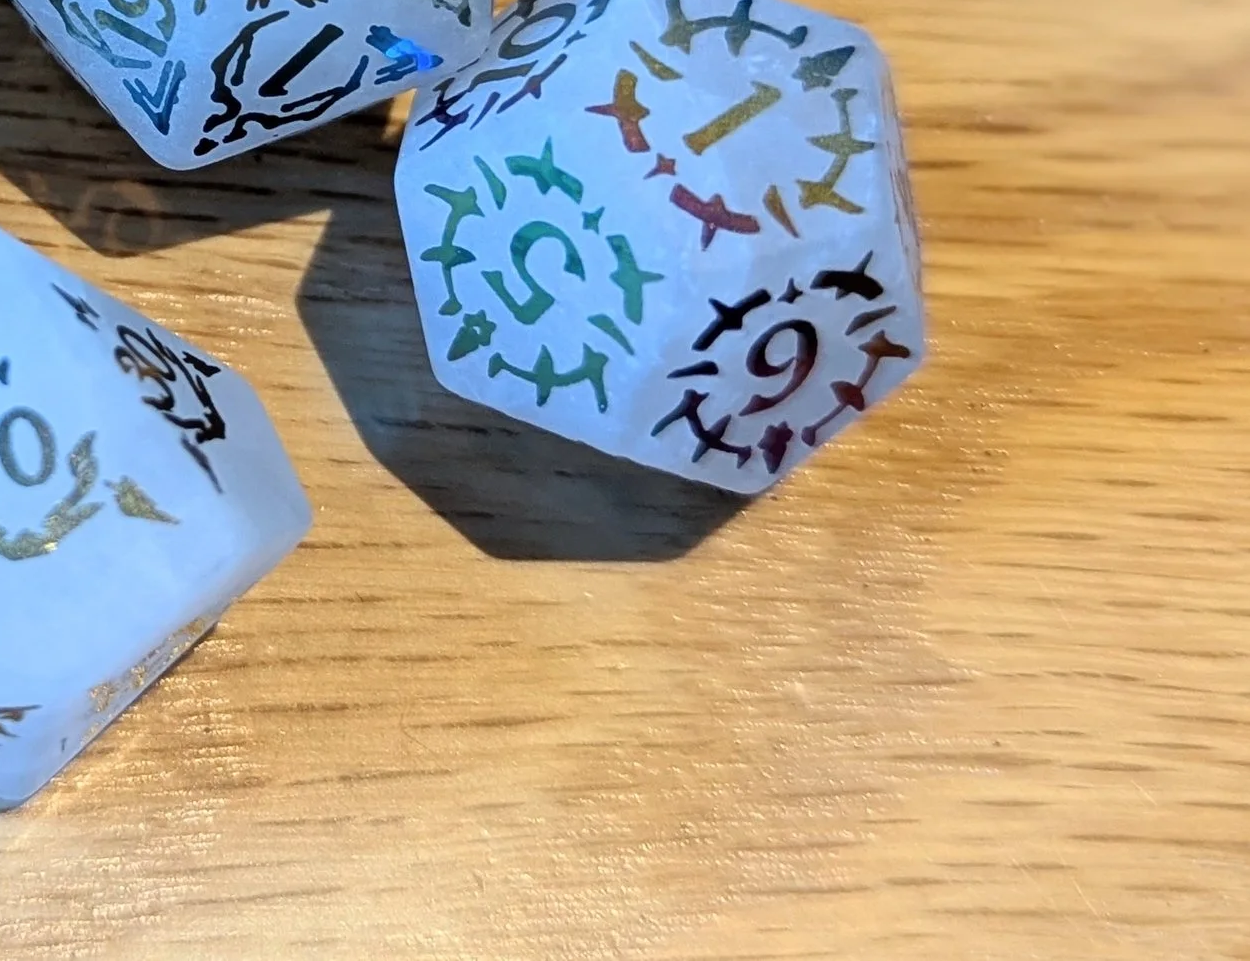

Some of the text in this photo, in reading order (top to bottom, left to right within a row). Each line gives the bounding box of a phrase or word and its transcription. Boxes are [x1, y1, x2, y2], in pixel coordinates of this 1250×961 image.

[258, 23, 345, 97] 1
[683, 81, 782, 155] 1
[481, 221, 586, 325] 5
[113, 324, 177, 412] 30
